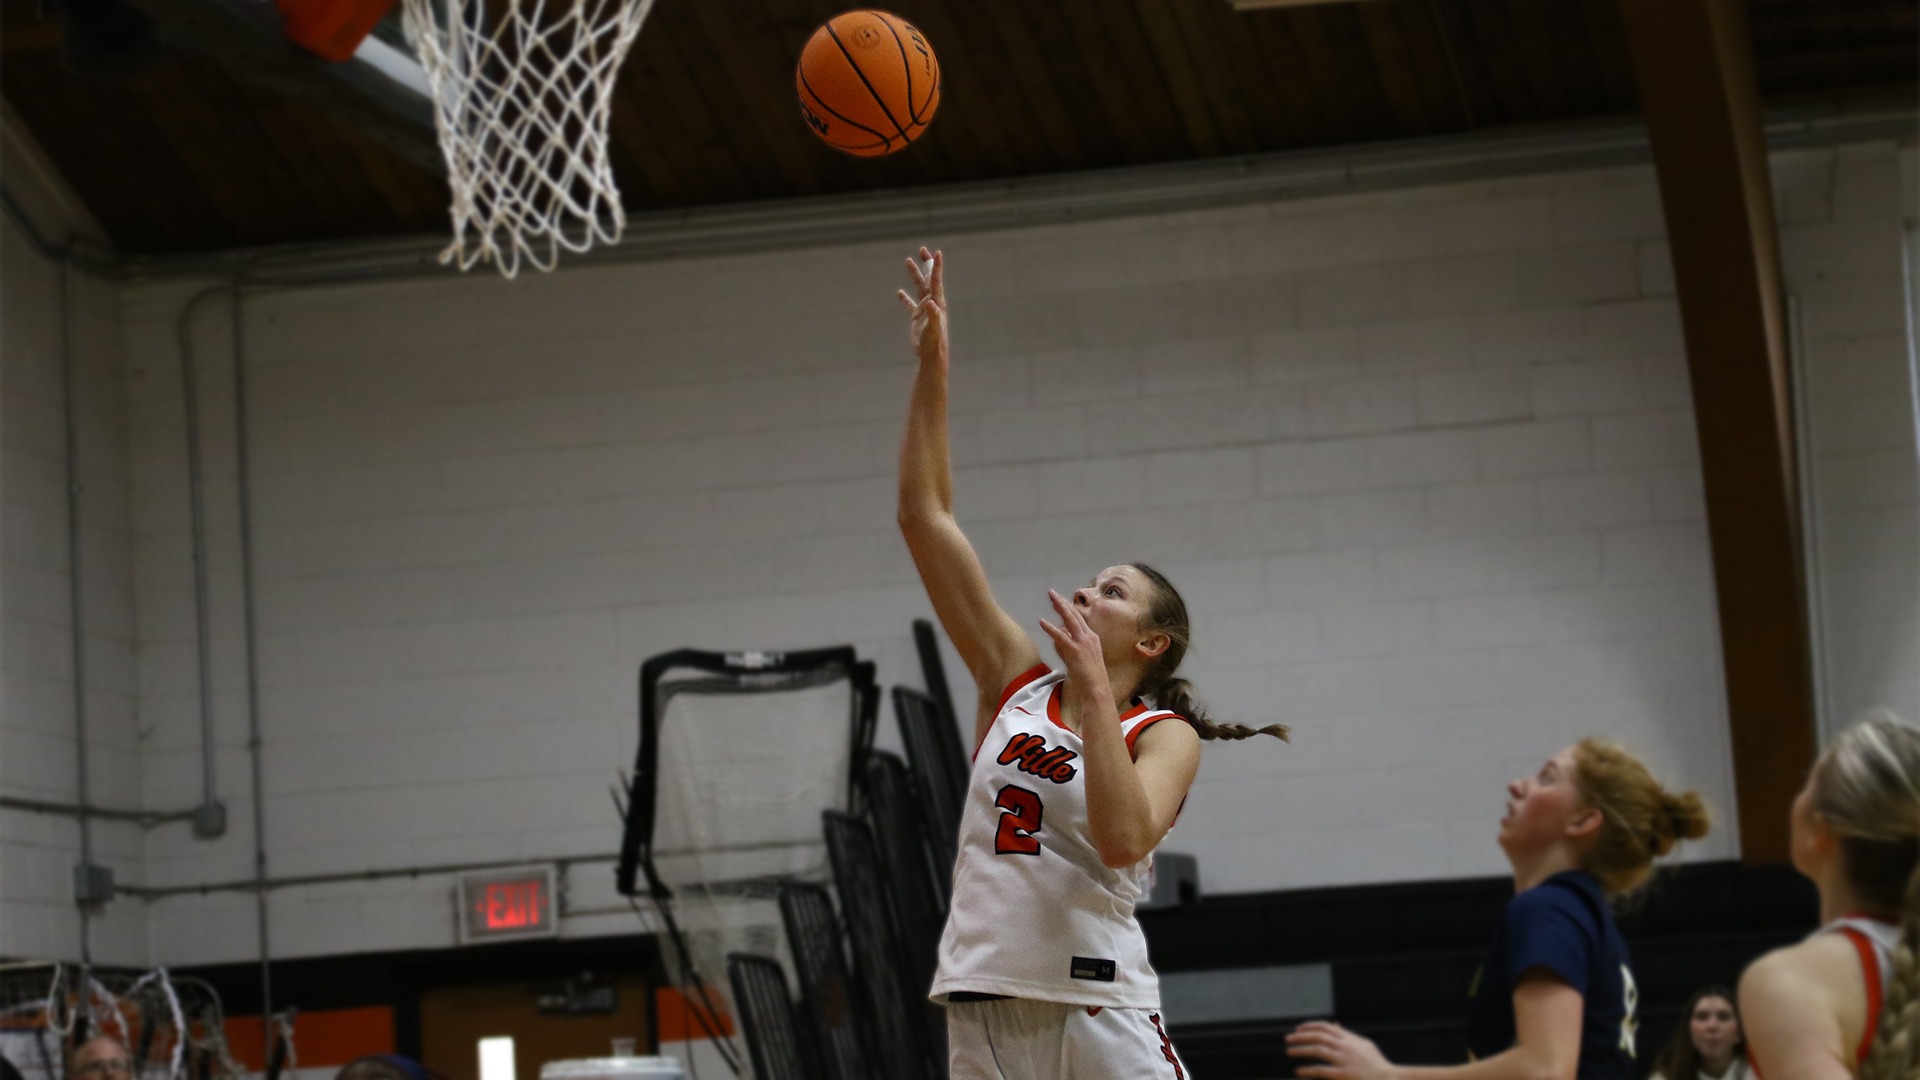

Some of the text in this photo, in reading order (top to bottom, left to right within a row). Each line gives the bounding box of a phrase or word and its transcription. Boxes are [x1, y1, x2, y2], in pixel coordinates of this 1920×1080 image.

[997, 732, 1078, 784] Ville
[995, 784, 1044, 856] 2
[486, 881, 542, 928] EXIT
